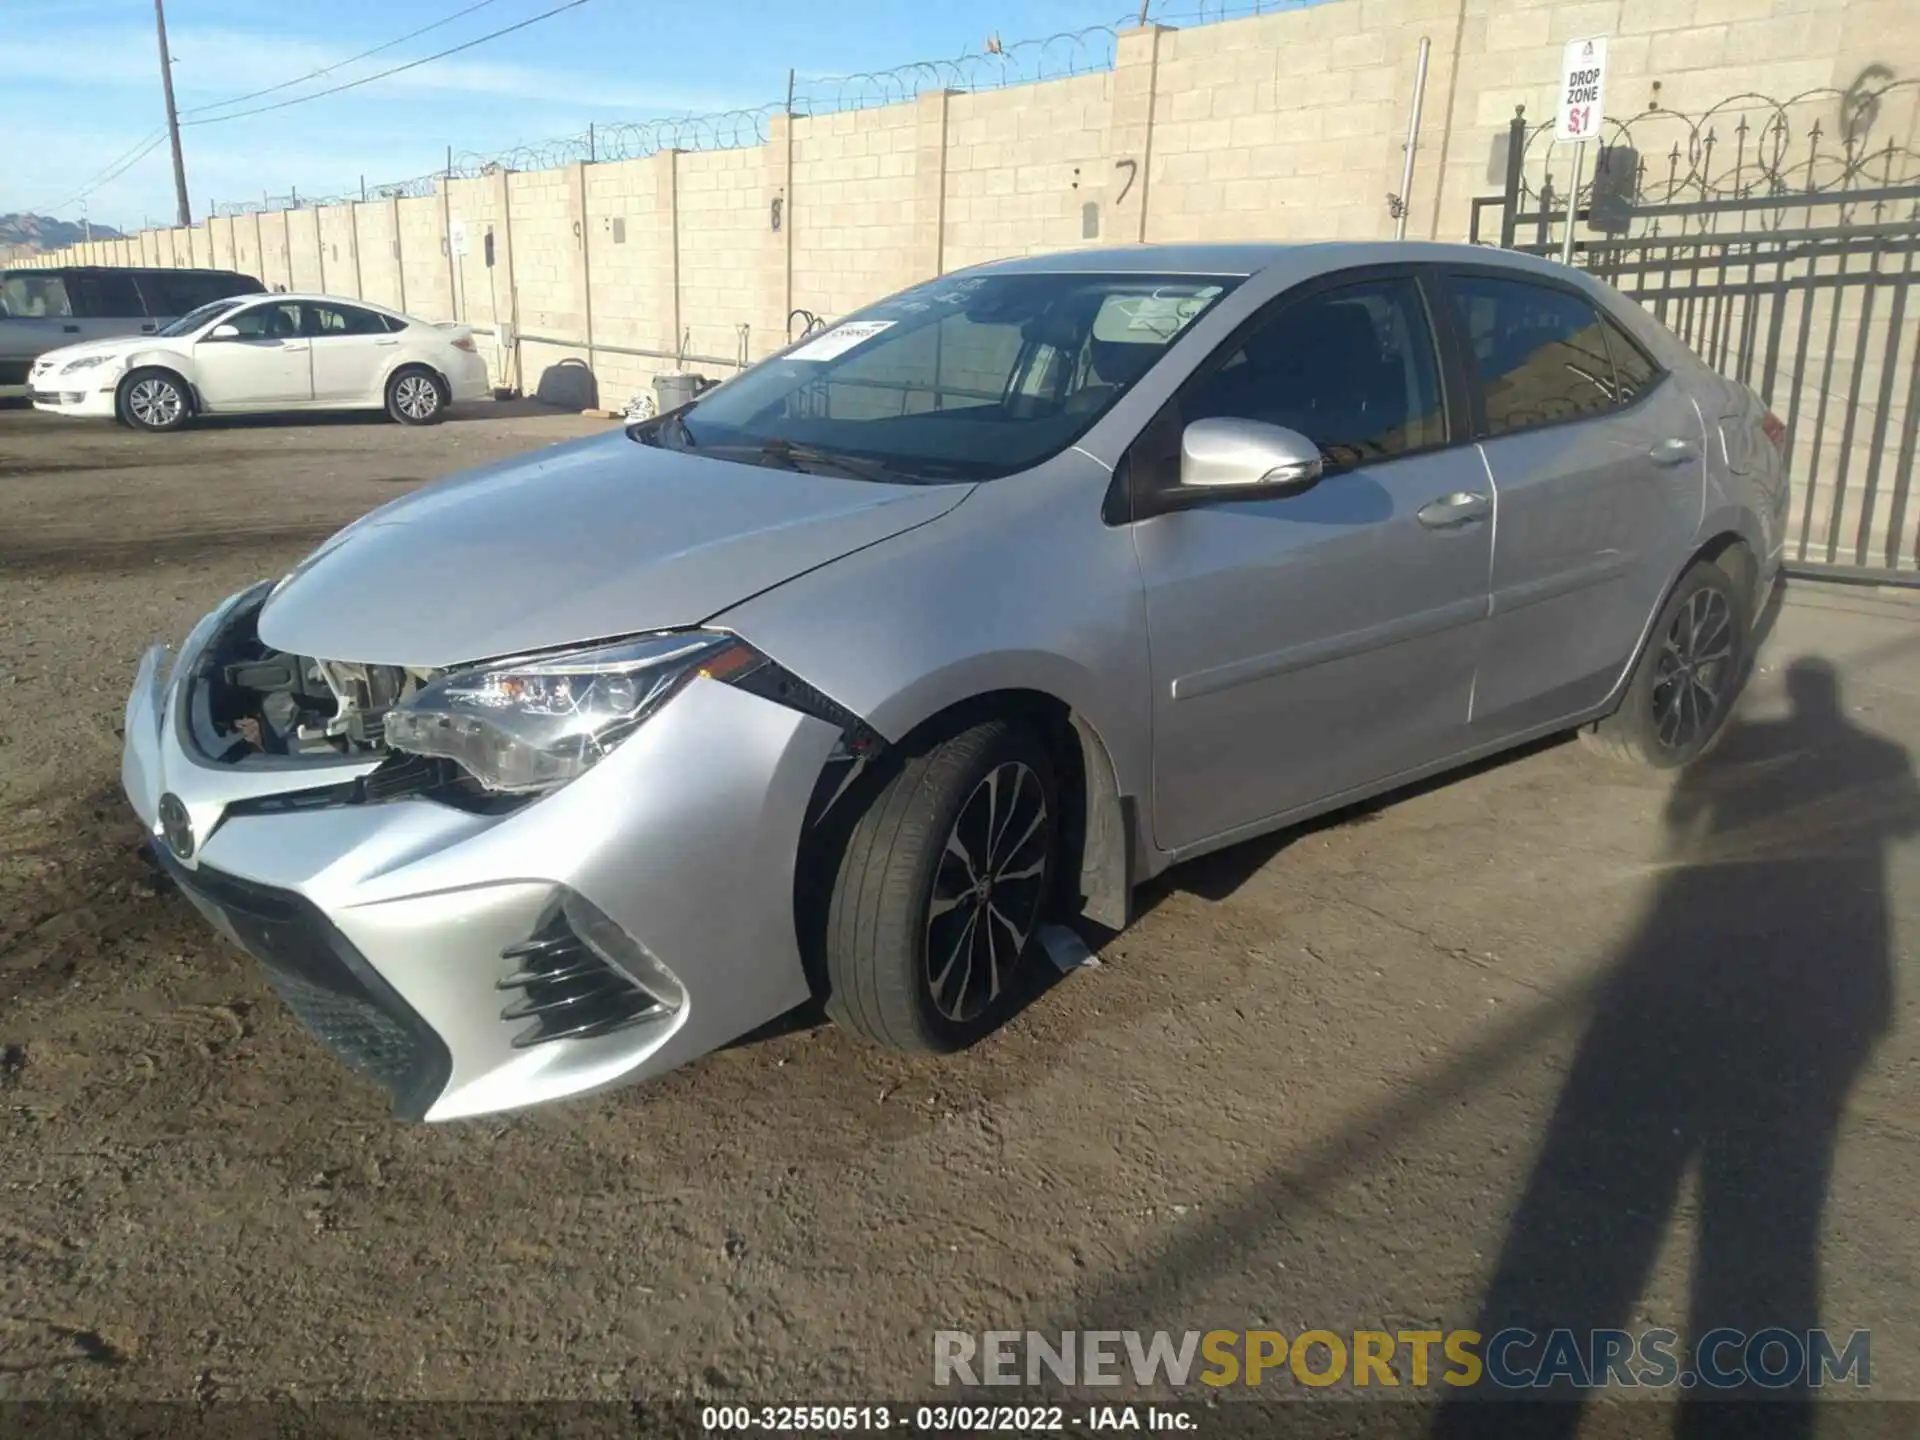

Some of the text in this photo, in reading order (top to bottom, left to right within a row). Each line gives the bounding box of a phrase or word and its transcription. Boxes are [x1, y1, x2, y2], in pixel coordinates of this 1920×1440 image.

[1569, 68, 1600, 87] DROP
[1567, 86, 1598, 104] ZONE
[1115, 159, 1138, 205] 7
